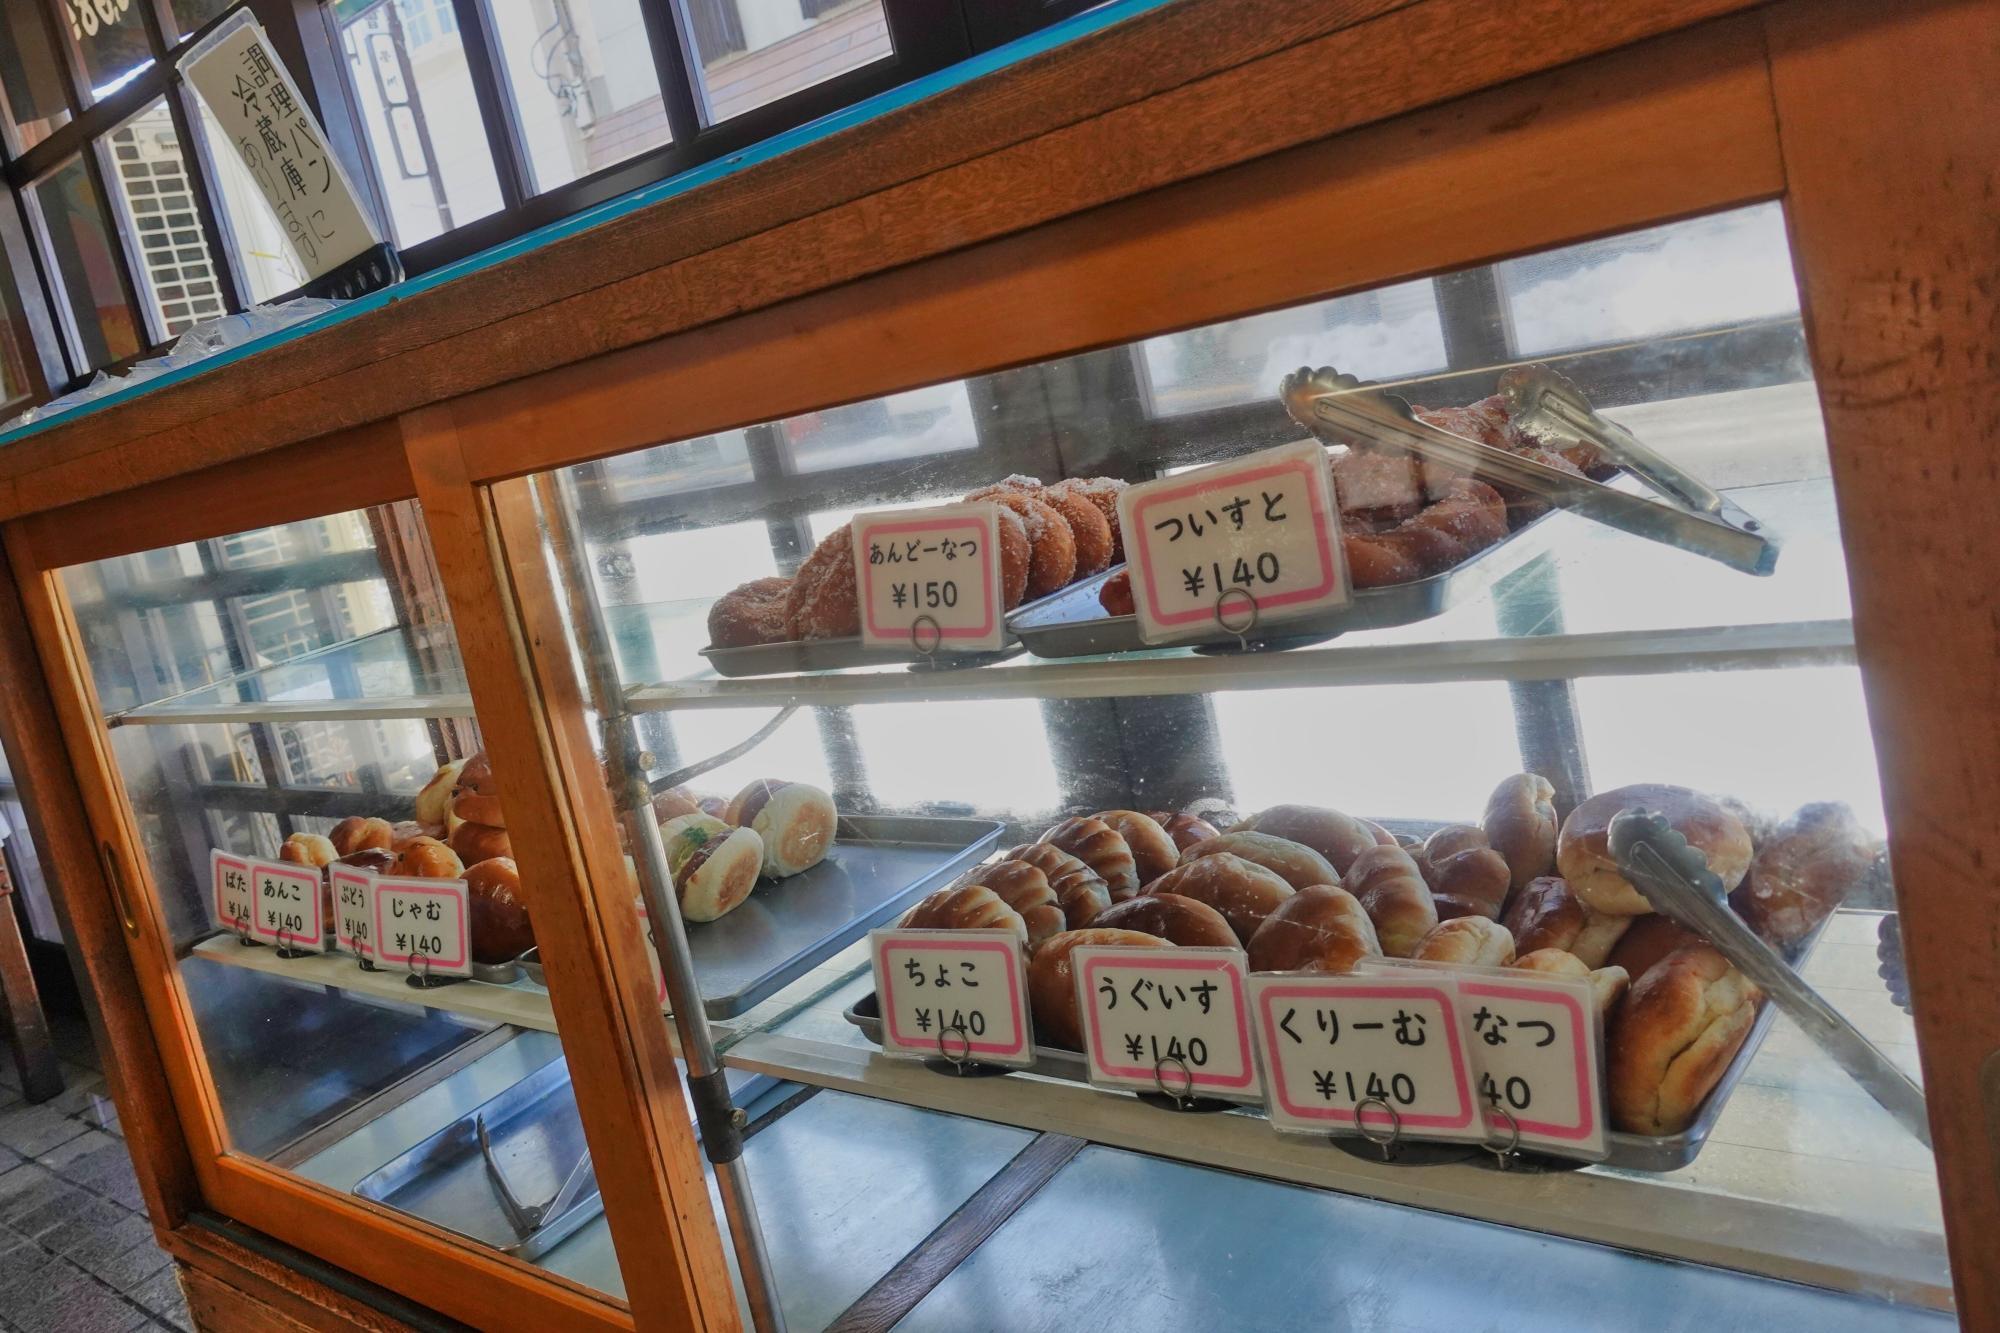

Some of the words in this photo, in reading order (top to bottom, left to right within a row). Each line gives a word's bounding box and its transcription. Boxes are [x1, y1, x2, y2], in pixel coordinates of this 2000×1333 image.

[240, 43, 331, 193] 調理パン
[1155, 491, 1288, 542] ついすと
[869, 538, 978, 565] あんどーなつ
[1182, 552, 1281, 598] ¥140
[892, 581, 958, 609] ¥150
[264, 878, 301, 901] あんこ
[341, 885, 364, 909] ぶどう
[267, 910, 302, 931] ¥140
[392, 898, 441, 921] じゃむ
[345, 917, 367, 939] ¥140
[396, 933, 442, 954] ¥140
[904, 957, 979, 987] ちょこ
[1099, 976, 1218, 1014] うぐいす
[915, 1008, 986, 1036] ¥140
[1280, 1008, 1426, 1046] くりーむ
[1124, 1034, 1208, 1067] ¥140
[1312, 1070, 1416, 1105] ¥140
